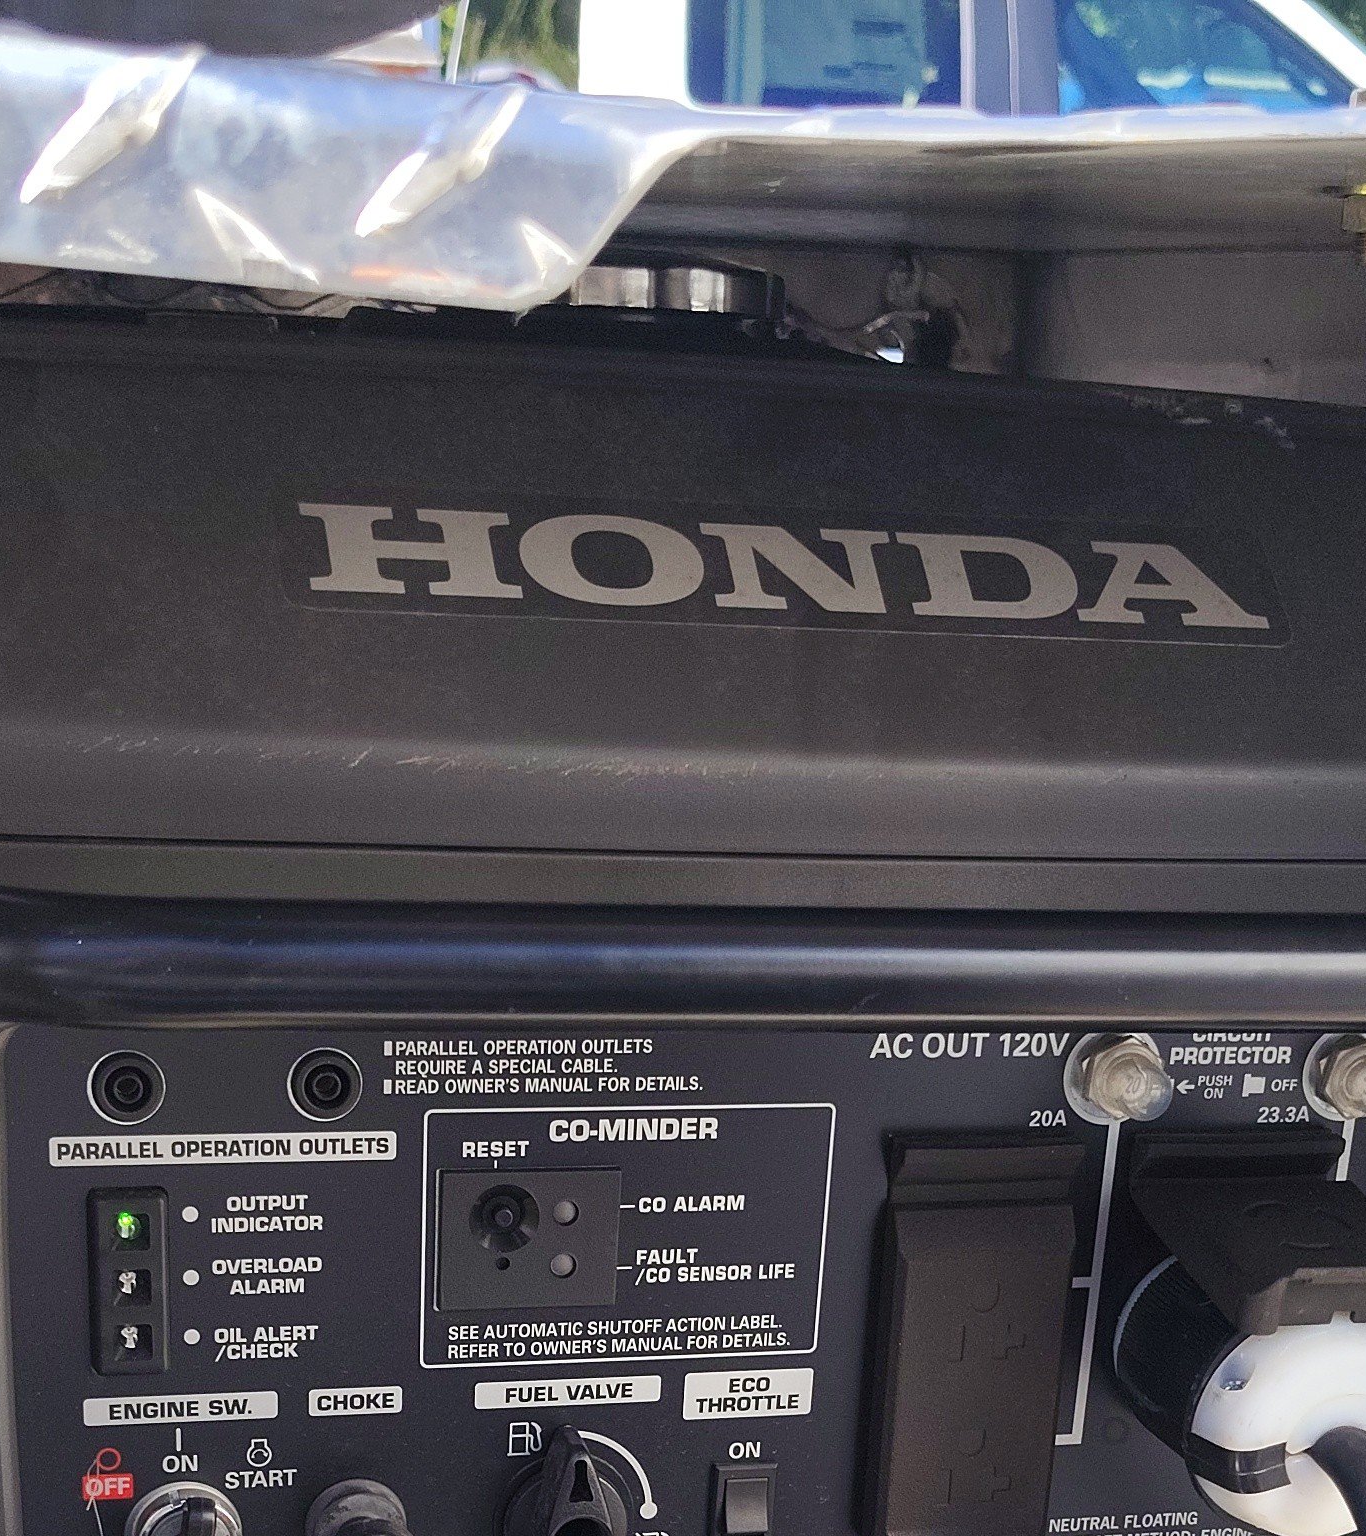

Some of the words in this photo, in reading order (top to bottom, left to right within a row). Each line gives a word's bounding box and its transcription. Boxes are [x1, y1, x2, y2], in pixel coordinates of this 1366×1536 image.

[297, 502, 1270, 630] HONDA
[395, 1041, 478, 1056] PARALLEL
[483, 1040, 576, 1055] OPERATION
[581, 1039, 653, 1054] OUTLETS
[869, 1033, 914, 1059] AC
[921, 1033, 990, 1058] OUT
[998, 1032, 1070, 1057] 120V
[1169, 1046, 1292, 1065] PROTECTOR
[395, 1060, 466, 1077] REQUIRE
[471, 1061, 483, 1074] A
[488, 1060, 556, 1074] SPECIAL
[561, 1059, 618, 1073] CABLE.
[395, 1079, 439, 1094] READ
[444, 1078, 520, 1093] OWNER'S
[525, 1078, 593, 1093] MANUAL
[598, 1078, 630, 1092] FOR
[635, 1076, 704, 1091] DETAILS.
[1197, 1075, 1233, 1087] PUSH
[1271, 1079, 1298, 1092] OFF
[1203, 1087, 1223, 1100] ON
[1029, 1110, 1067, 1127] 20A
[1257, 1106, 1310, 1124] 23.3A
[548, 1118, 719, 1142] CO-MINDER
[56, 1141, 164, 1160] PARALLEL
[170, 1139, 291, 1158] OPERATION
[299, 1137, 389, 1156] OUTLETS
[462, 1141, 530, 1158] RESET
[226, 1194, 308, 1212] OUTPUT
[638, 1197, 666, 1213] CO
[673, 1195, 746, 1212] ALARM
[210, 1216, 323, 1233] INDICATOR
[635, 1248, 698, 1265] FAULT
[211, 1257, 323, 1275] OVERLOAD
[634, 1266, 671, 1286] /CO
[677, 1265, 752, 1282] SENSOR
[758, 1263, 795, 1280] LIFE
[229, 1278, 305, 1295] ALARM
[214, 1327, 247, 1344] OIL
[253, 1325, 318, 1342] ALERT
[448, 1326, 479, 1341] SEE
[484, 1321, 583, 1339] AUTOMATIC
[587, 1319, 662, 1336] SHUTOFF
[666, 1316, 725, 1333] ACTION
[731, 1314, 782, 1330] LABEL.
[214, 1342, 299, 1362] /CHECK
[447, 1343, 499, 1359] REFER
[504, 1342, 526, 1357] TO
[530, 1339, 607, 1356] OWNER'S
[611, 1336, 682, 1353] MANUAL
[687, 1334, 717, 1349] FOR
[722, 1331, 790, 1348] DETAILS.
[505, 1385, 559, 1403] FUEL
[566, 1382, 633, 1400] VALVE
[728, 1377, 771, 1393] ECO
[109, 1400, 199, 1420] ENGINE
[208, 1399, 252, 1416] SW.
[316, 1392, 395, 1411] CHOKE
[696, 1394, 799, 1413] THROTTLE
[728, 1442, 761, 1459] ON
[162, 1454, 198, 1472] ON
[86, 1478, 130, 1496] OFF
[225, 1469, 297, 1489] START
[1048, 1516, 1119, 1533] NEUTRAL
[1124, 1512, 1198, 1528] FLOATING
